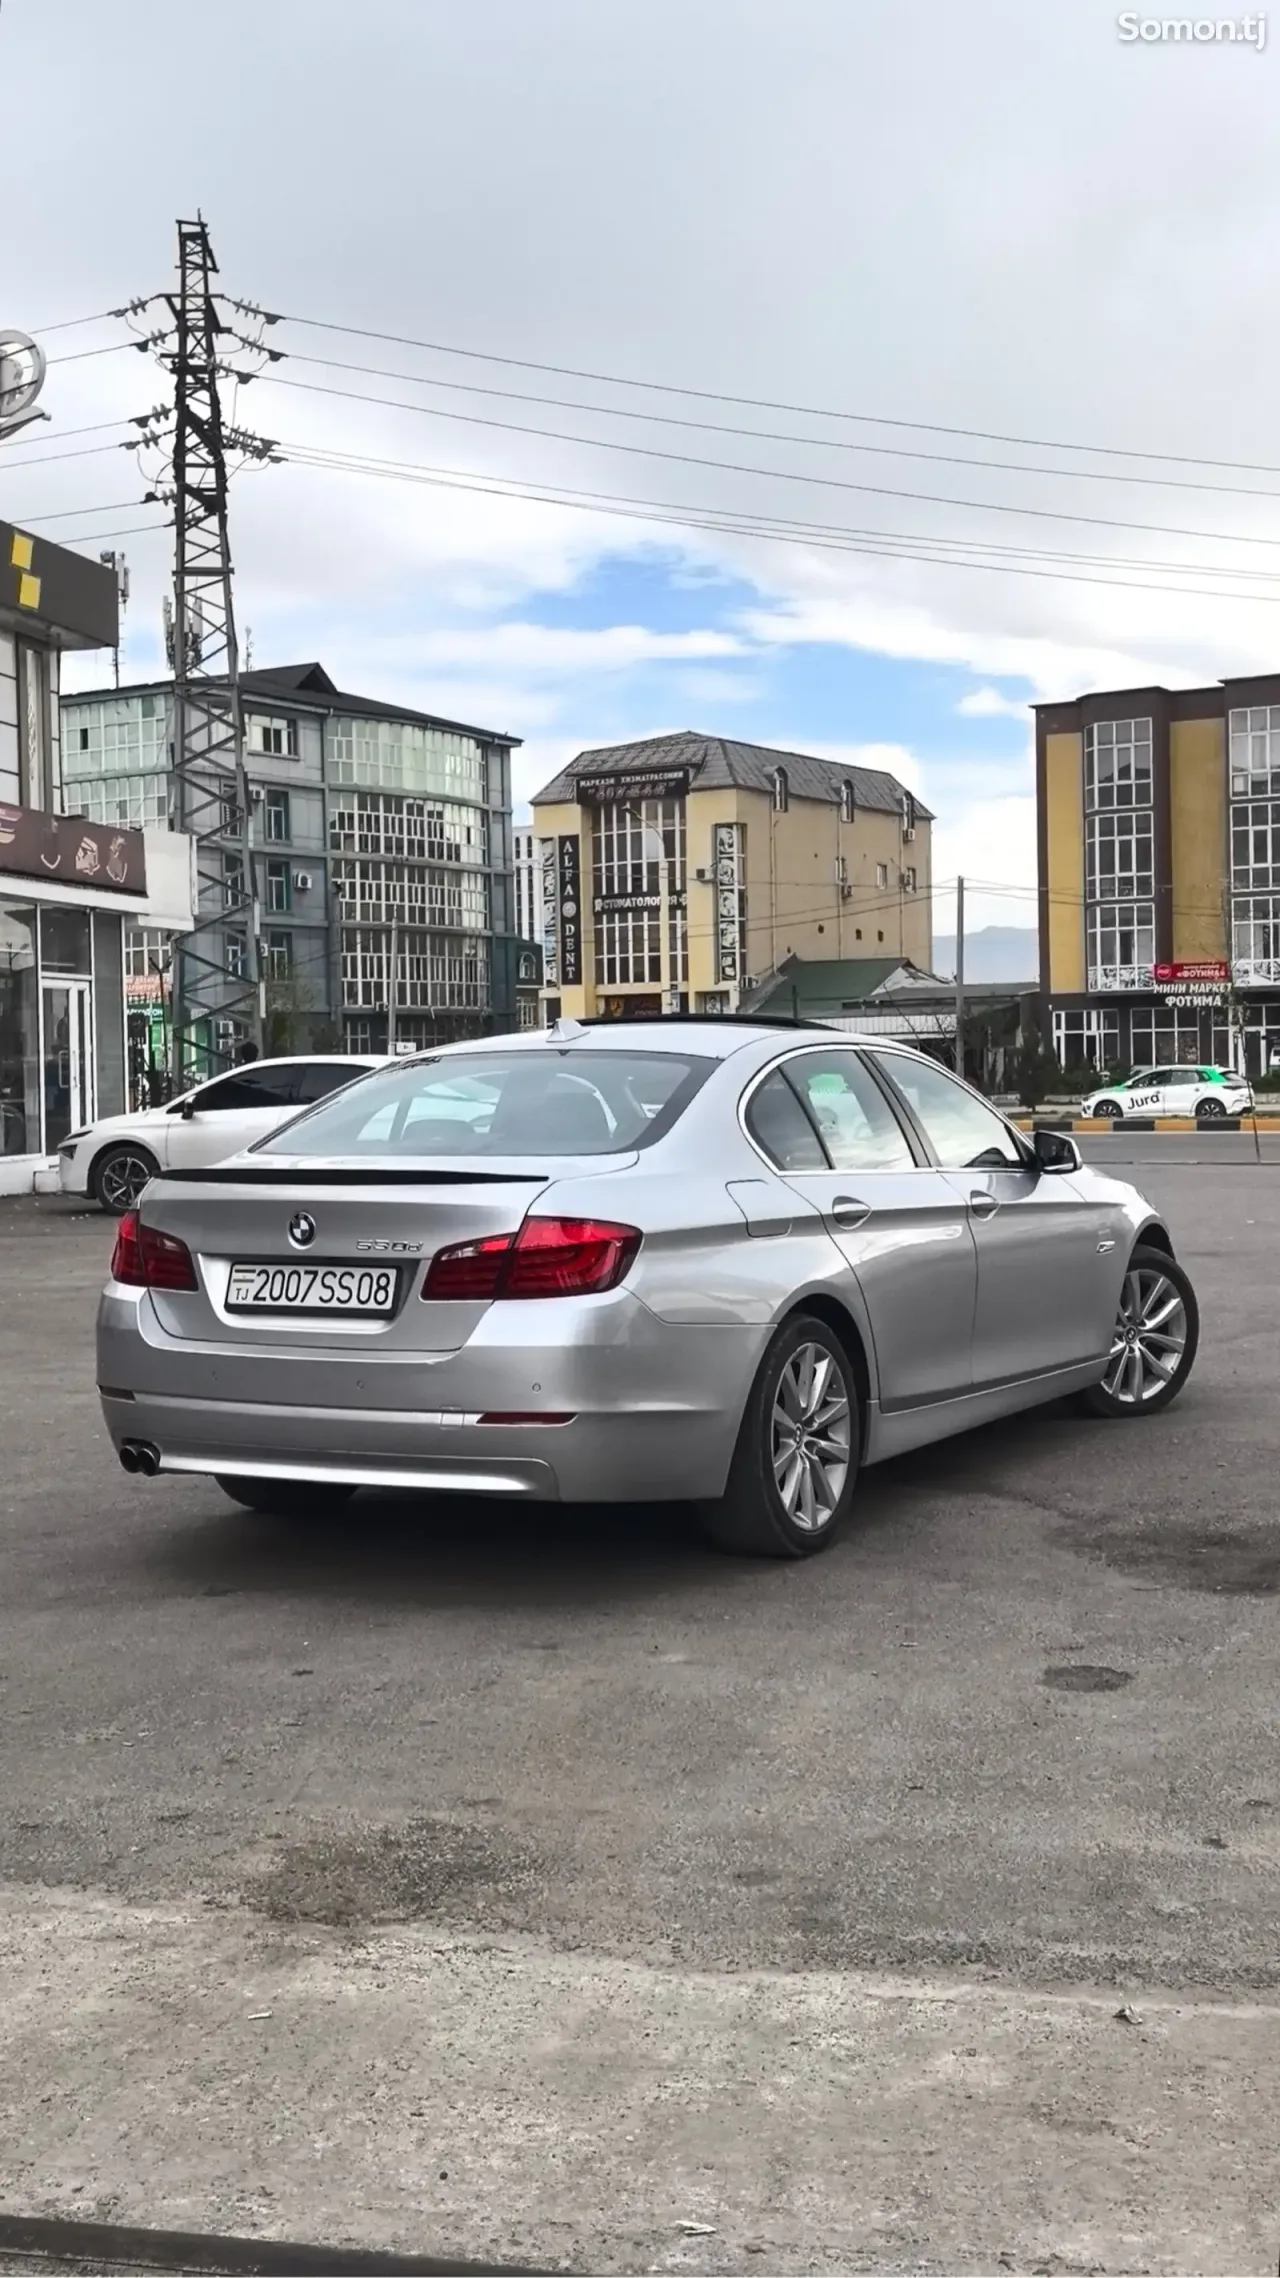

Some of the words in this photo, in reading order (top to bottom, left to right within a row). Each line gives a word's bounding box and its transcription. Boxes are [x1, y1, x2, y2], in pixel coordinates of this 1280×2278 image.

[563, 841, 573, 896] ALFA
[603, 895, 677, 909] СТОМАТОЛОГЯ
[565, 924, 576, 979] DENT
[1153, 983, 1186, 993] МИНИ
[1189, 982, 1232, 993] МАРКЕТ
[1165, 995, 1221, 1007] ФОТИМА
[1128, 1093, 1160, 1110] Jura
[236, 1288, 249, 1300] TJ
